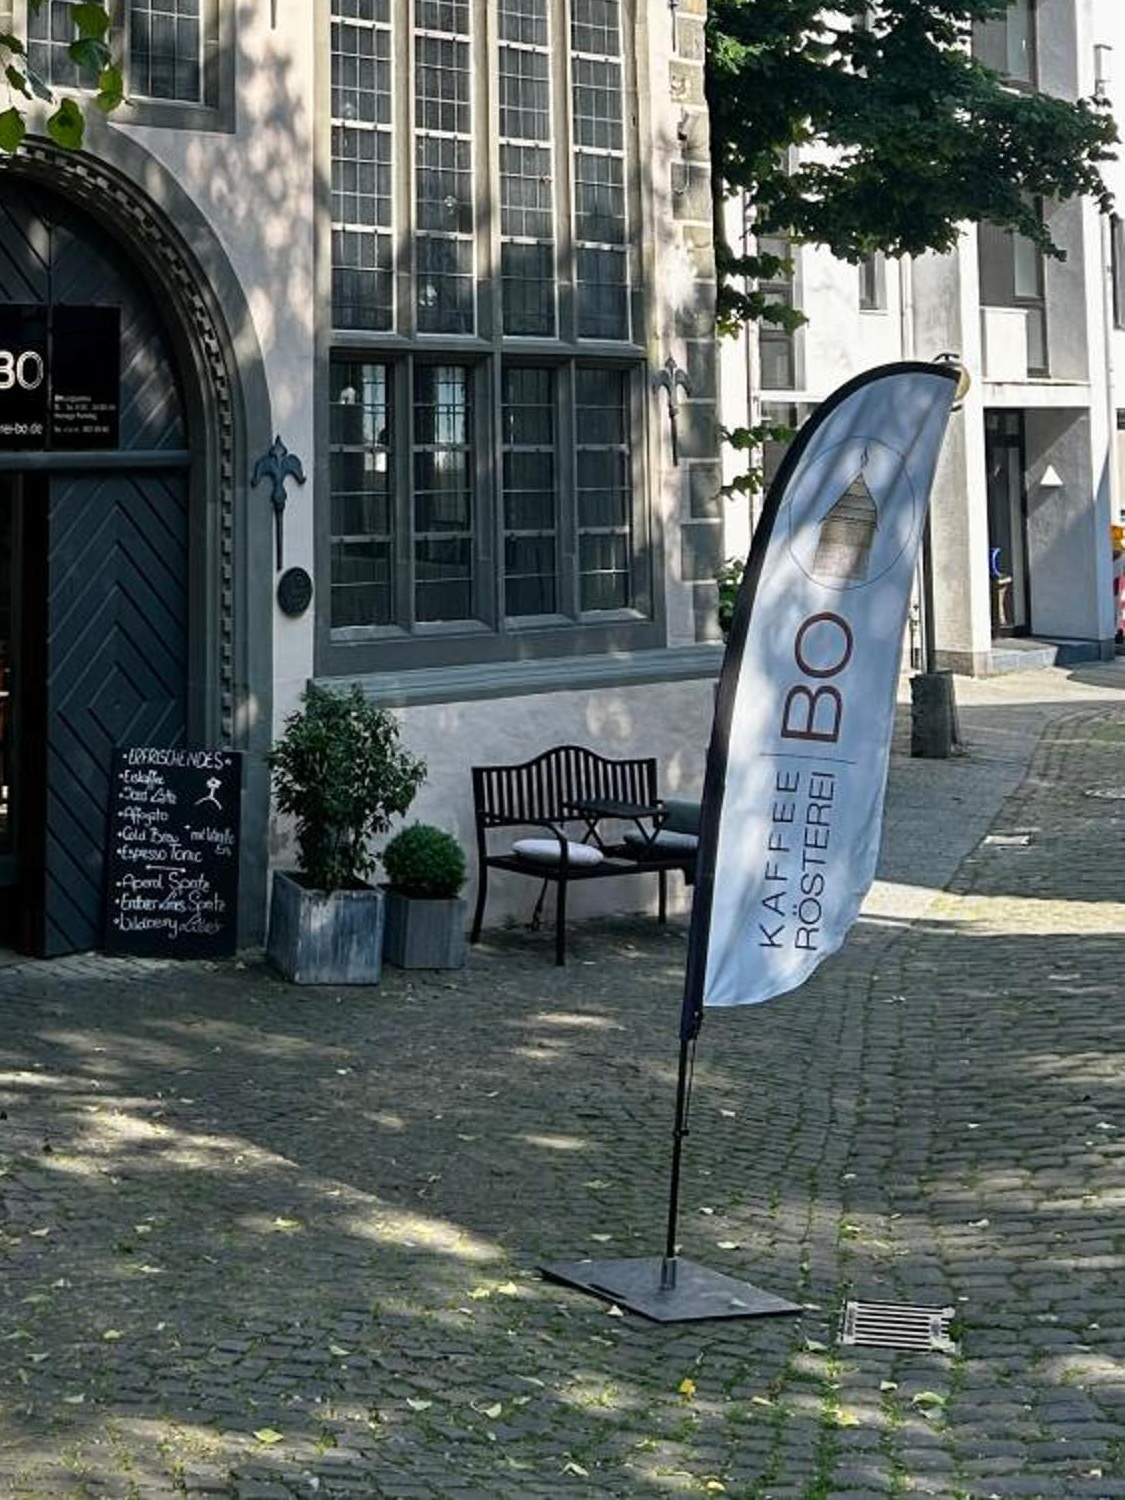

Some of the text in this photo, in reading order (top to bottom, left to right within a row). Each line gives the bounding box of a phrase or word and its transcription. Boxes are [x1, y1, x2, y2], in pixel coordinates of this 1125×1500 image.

[780, 611, 855, 744] BO
[128, 748, 224, 770] ERFRISCHENDES
[122, 826, 146, 841] Cold
[121, 843, 203, 863] Espresso Tonic
[758, 769, 801, 948] KAFFEE
[794, 770, 837, 952] RÖSTEREI
[122, 874, 163, 892] Aperol
